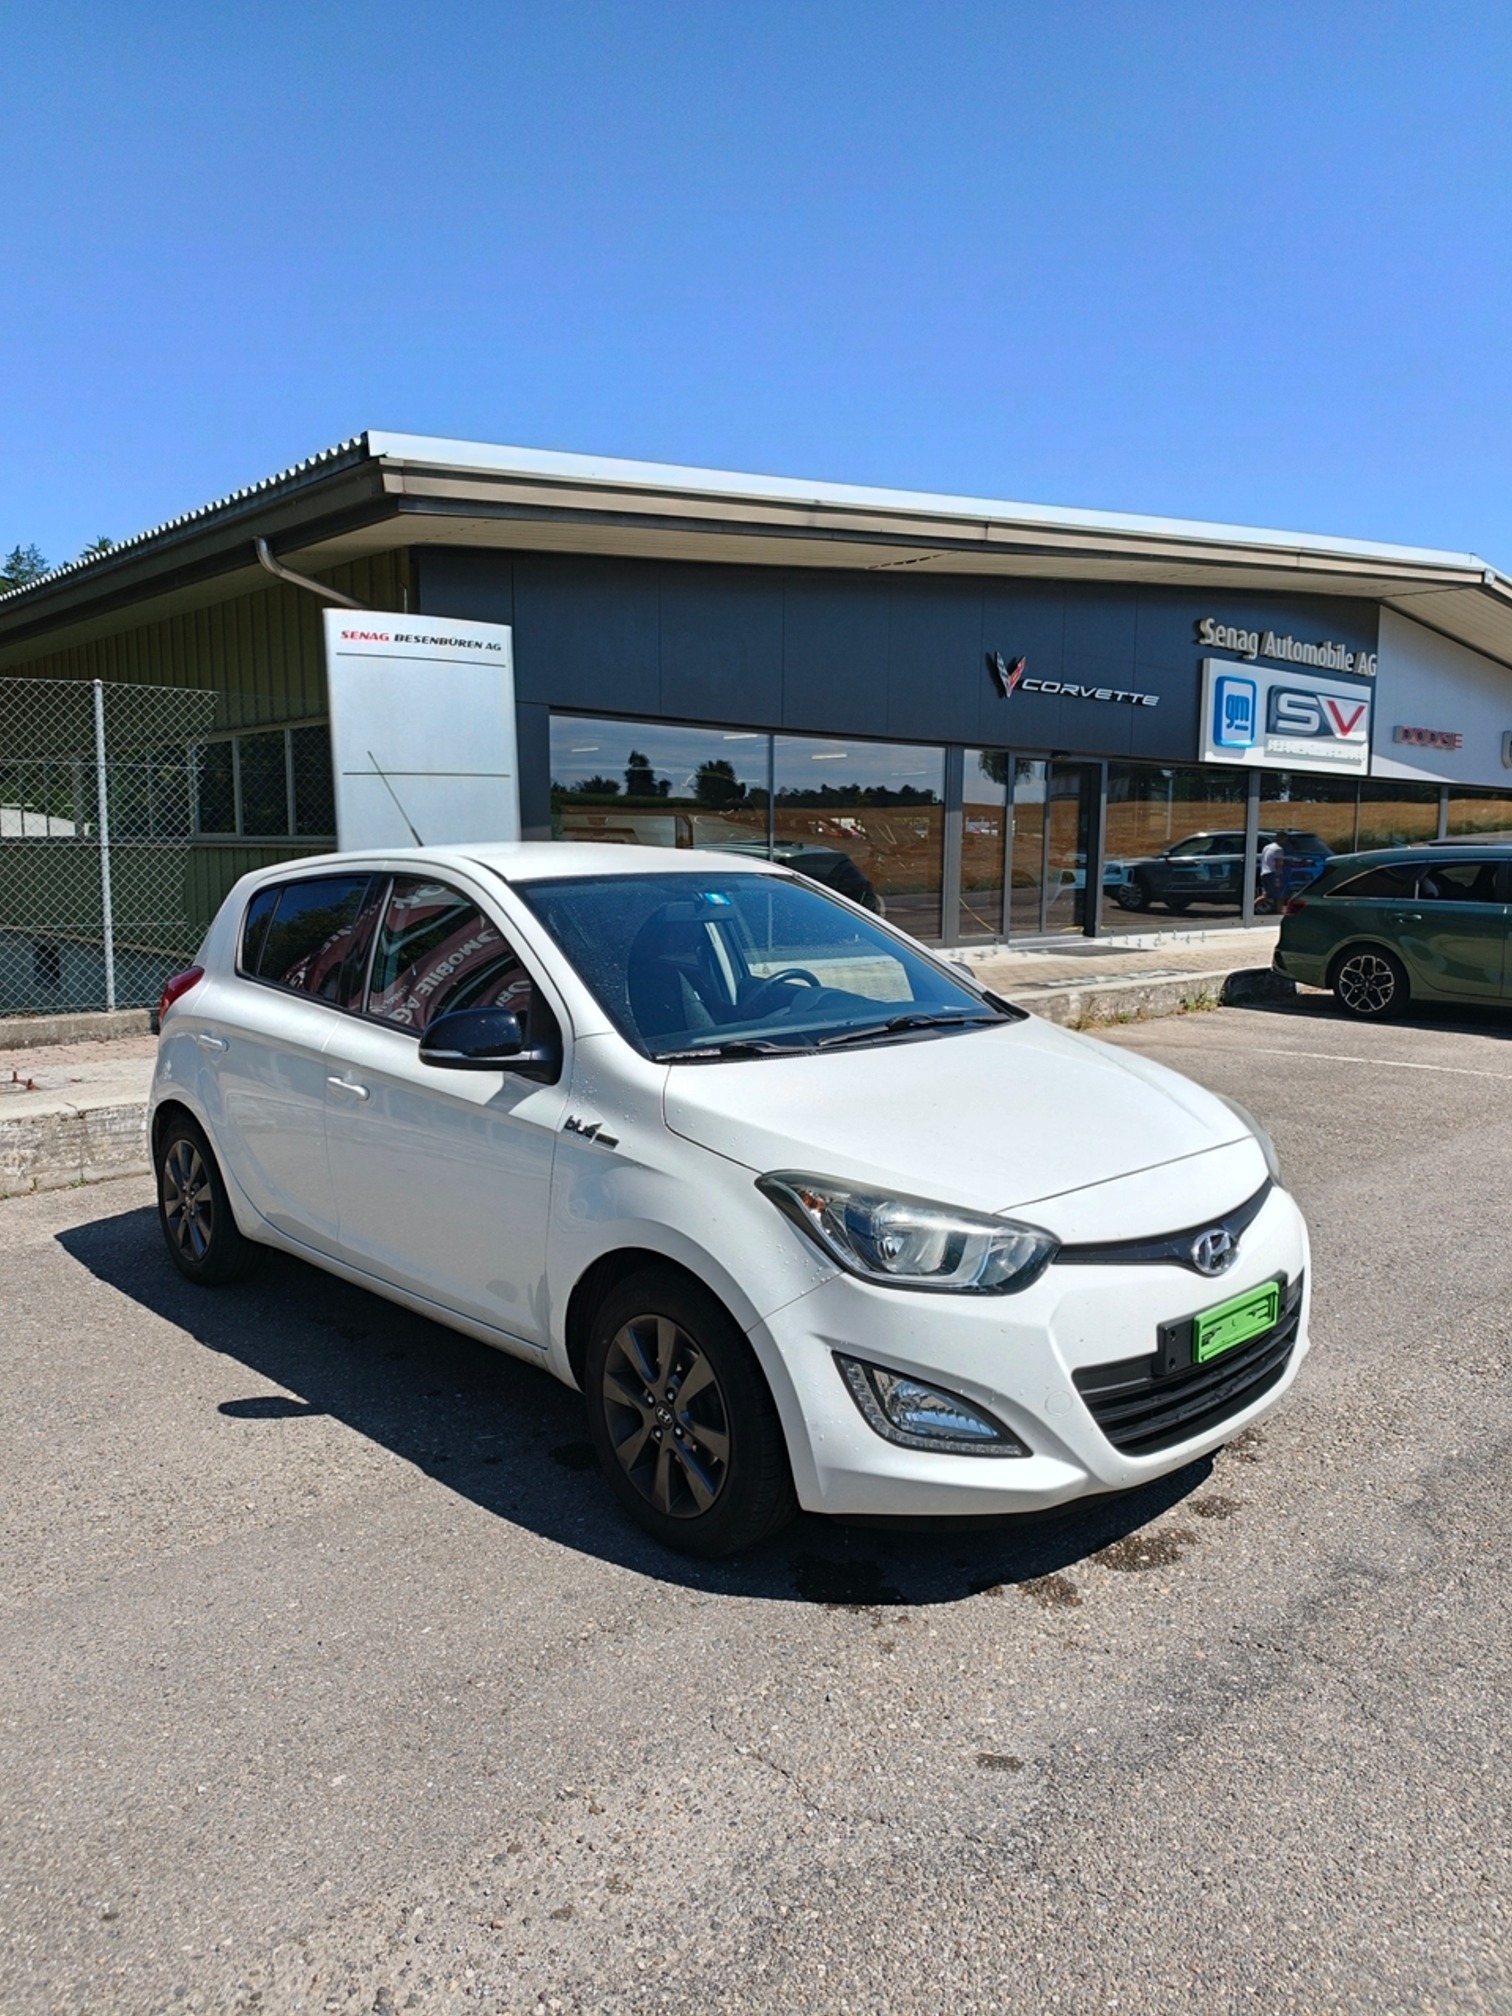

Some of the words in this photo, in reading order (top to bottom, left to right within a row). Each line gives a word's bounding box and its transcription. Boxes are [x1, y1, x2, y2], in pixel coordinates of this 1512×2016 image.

[340, 630, 390, 642] SENAG
[394, 633, 484, 649] BESENBÜREN
[485, 642, 502, 652] AG
[1200, 617, 1258, 660] Senag
[1261, 630, 1354, 673] Automobile
[1355, 652, 1377, 677] AG
[1021, 677, 1161, 707] CORVETTE
[1399, 726, 1464, 750] DODGE
